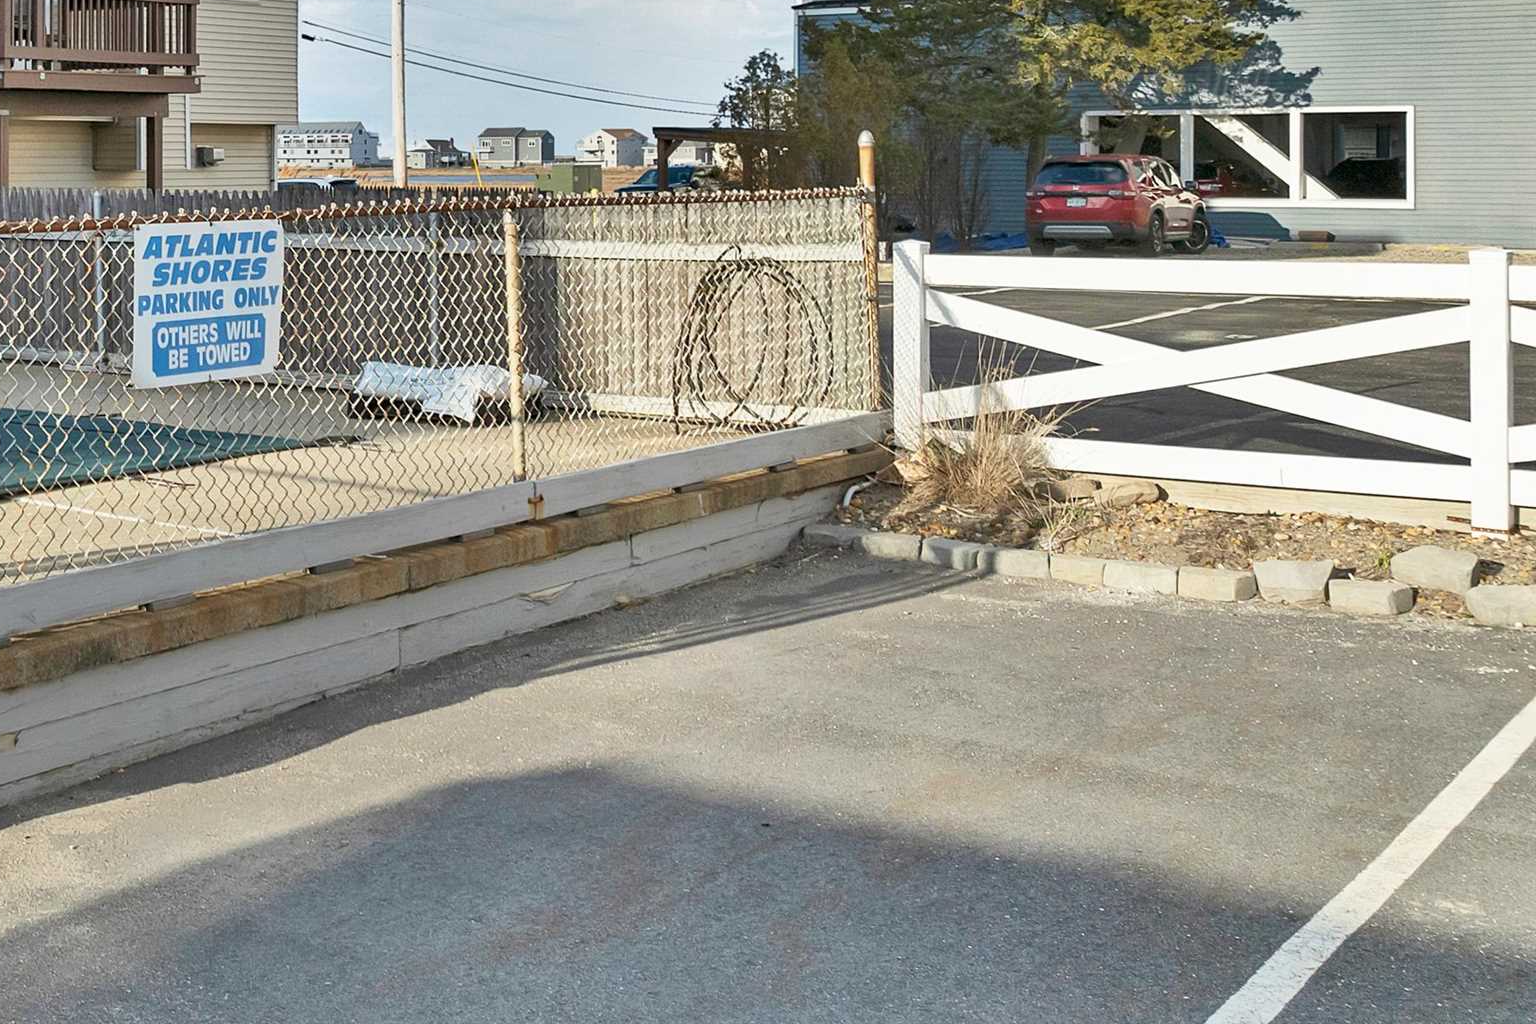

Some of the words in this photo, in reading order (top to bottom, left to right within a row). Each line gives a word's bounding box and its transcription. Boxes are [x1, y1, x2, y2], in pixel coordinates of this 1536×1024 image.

[142, 230, 278, 259] ATLANTIC
[152, 257, 268, 287] SHORES
[138, 290, 224, 316] PARKING
[234, 285, 280, 309] ONLY
[157, 322, 218, 349] OTHERS
[226, 319, 262, 340] WILL
[168, 348, 189, 370] BE
[196, 342, 251, 367] TOWED
